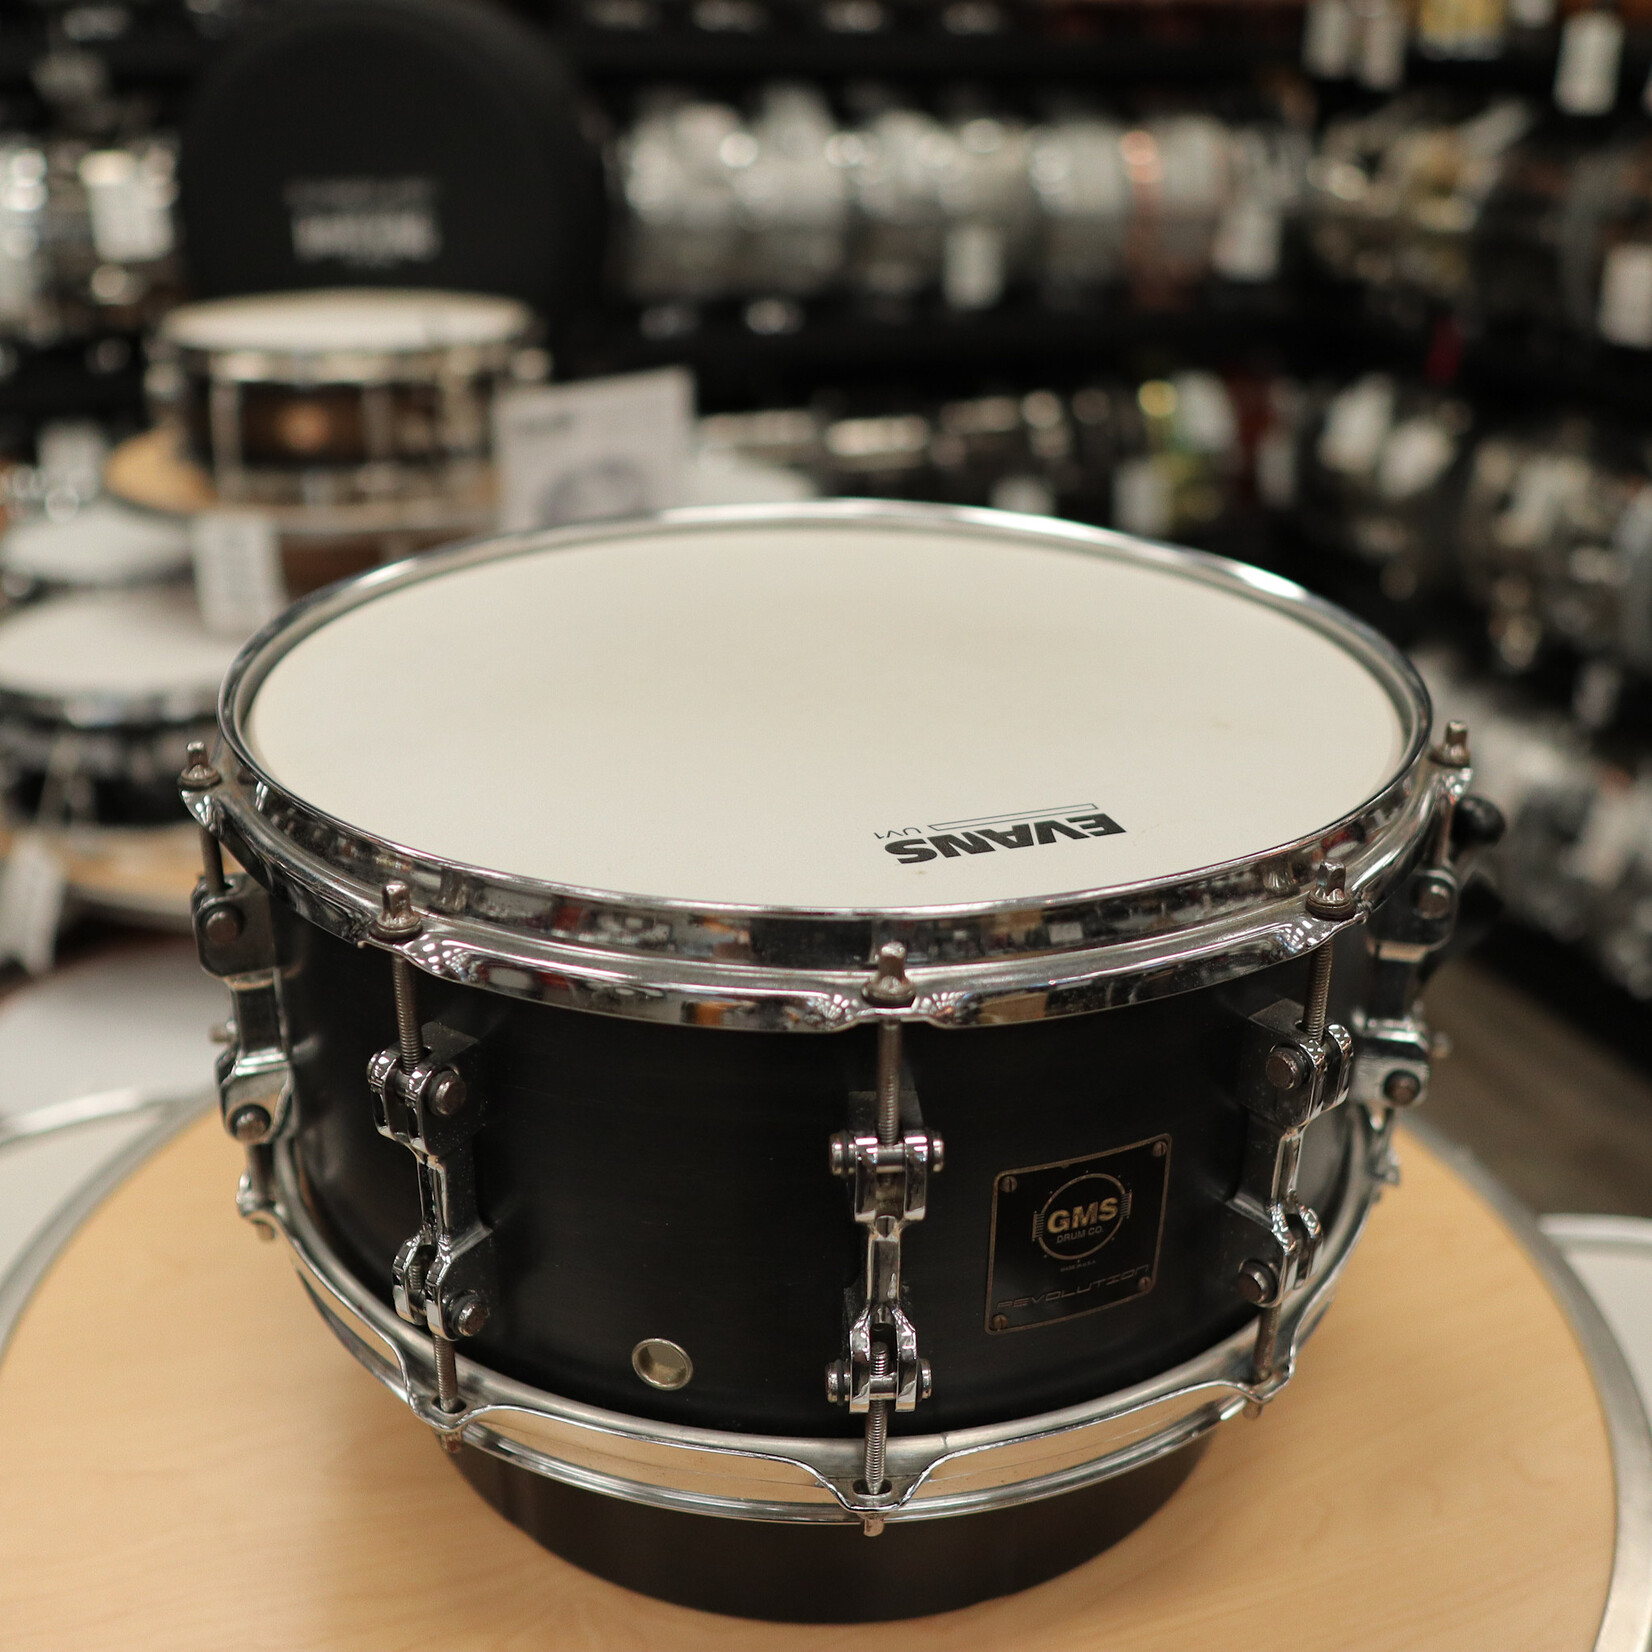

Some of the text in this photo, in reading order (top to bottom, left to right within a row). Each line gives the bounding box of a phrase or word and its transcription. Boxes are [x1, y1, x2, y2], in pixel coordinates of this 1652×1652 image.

[874, 827, 921, 840] UV1
[885, 813, 1127, 864] EVANS
[1048, 1197, 1118, 1233] GMS
[1056, 1229, 1086, 1243] DRUM
[996, 1264, 1149, 1310] REVOLUTION
